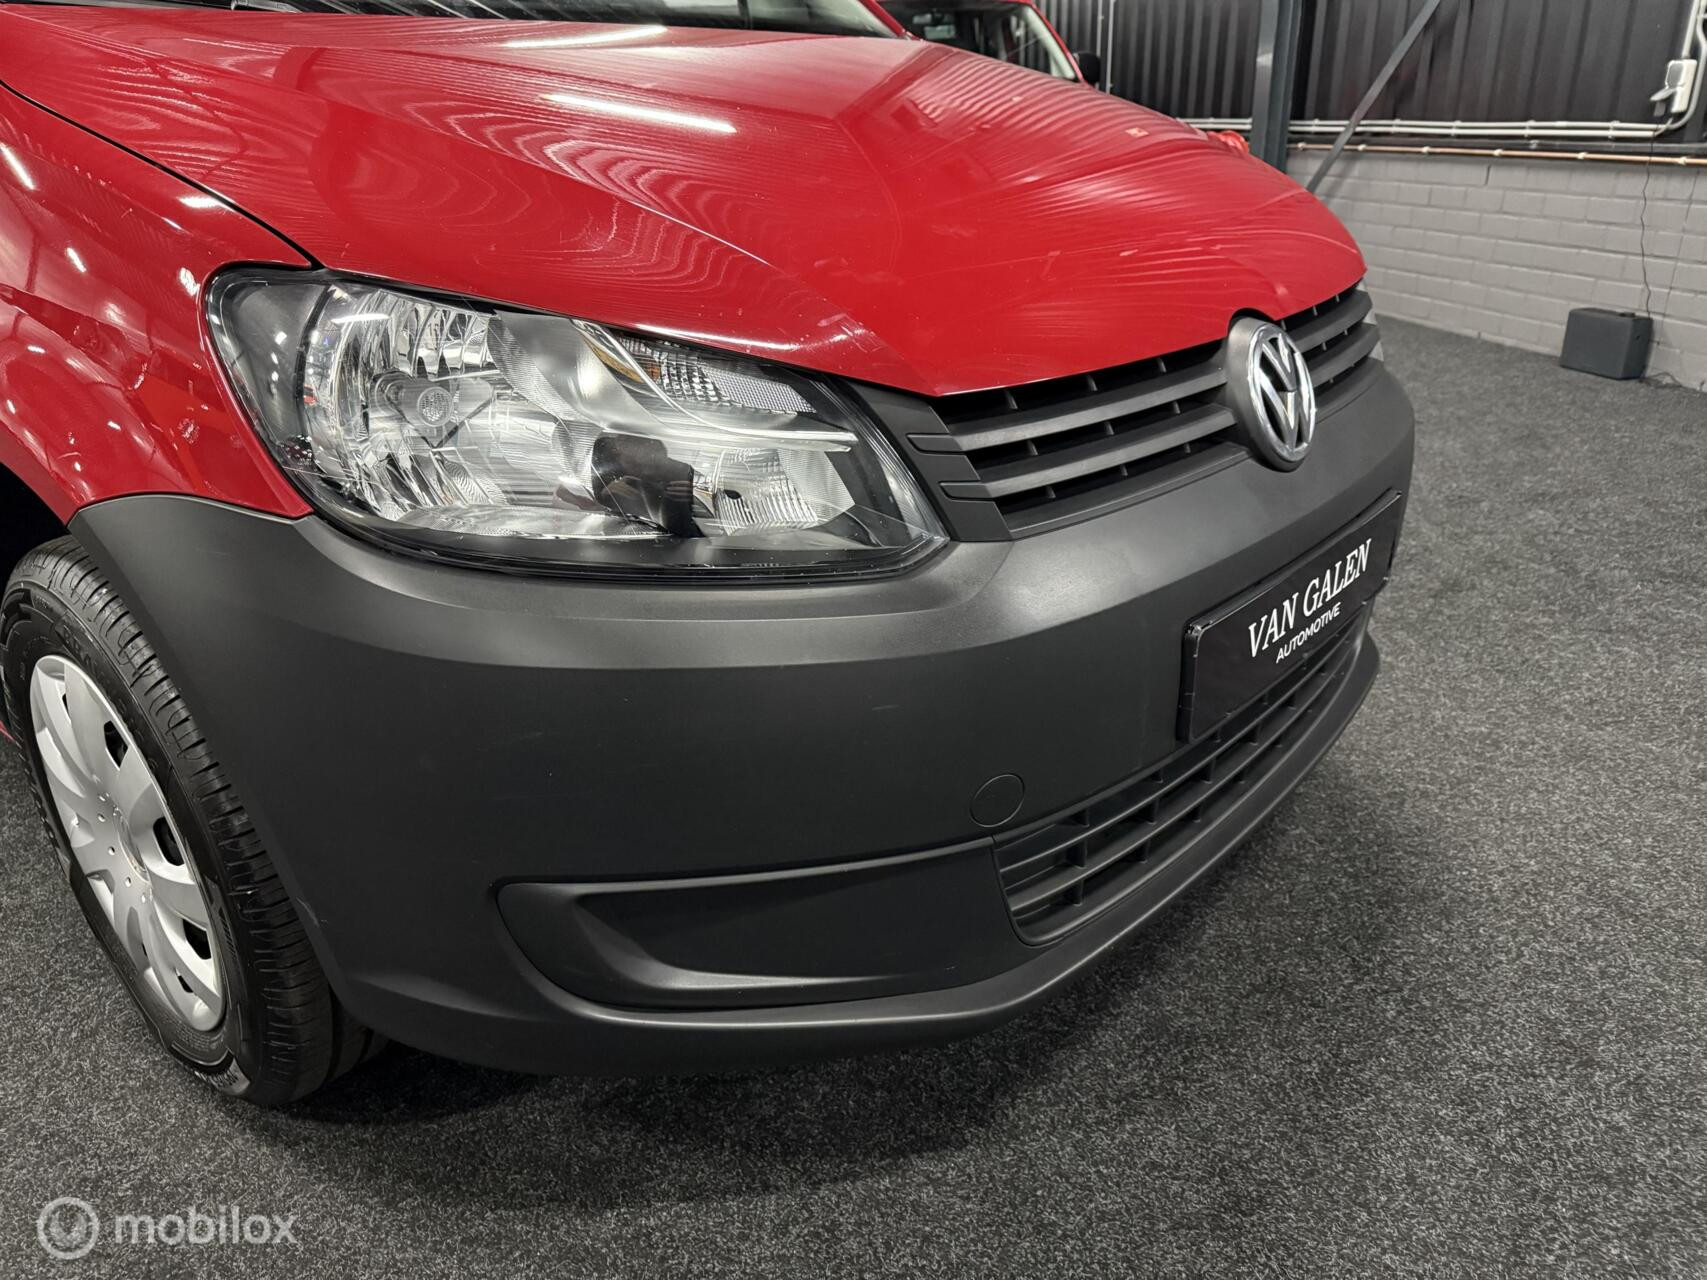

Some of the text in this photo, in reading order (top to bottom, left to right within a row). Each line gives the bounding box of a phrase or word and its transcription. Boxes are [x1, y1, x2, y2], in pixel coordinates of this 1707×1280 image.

[1248, 538, 1372, 657] VAN GALEN
[1275, 602, 1342, 664] AUTOMOTIVE
